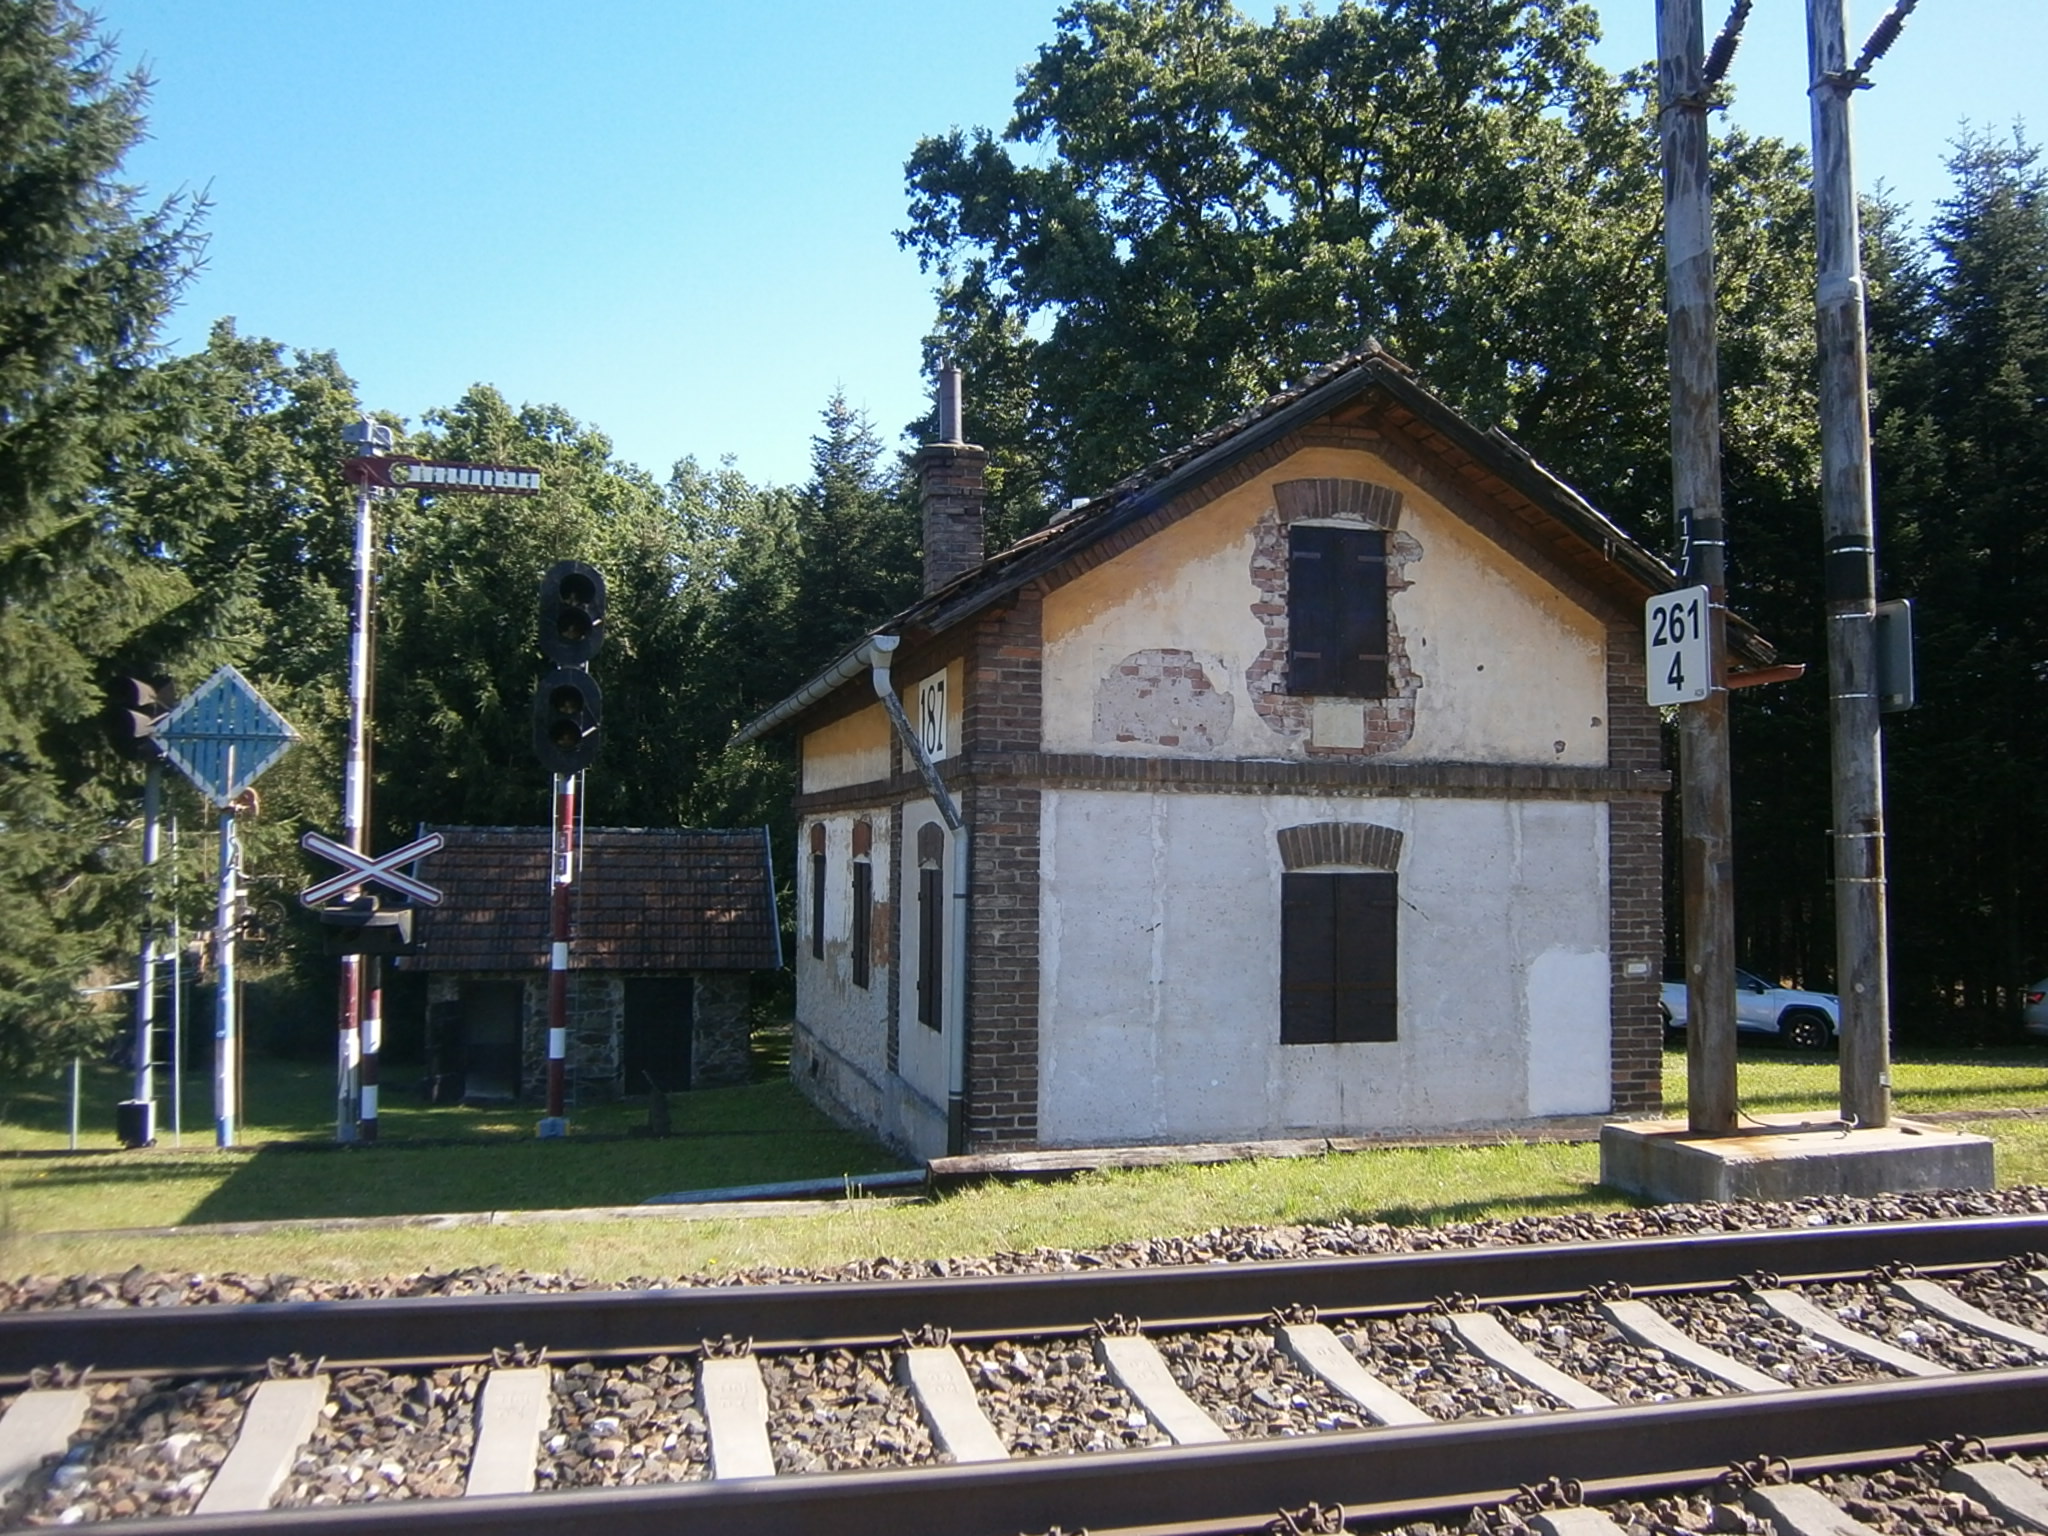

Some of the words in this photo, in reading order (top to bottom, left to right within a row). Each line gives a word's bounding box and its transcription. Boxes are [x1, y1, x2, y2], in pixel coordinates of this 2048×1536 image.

[1680, 515, 1690, 576] 177
[1652, 599, 1698, 647] 261
[1667, 651, 1684, 691] 4
[921, 680, 944, 755] 187
